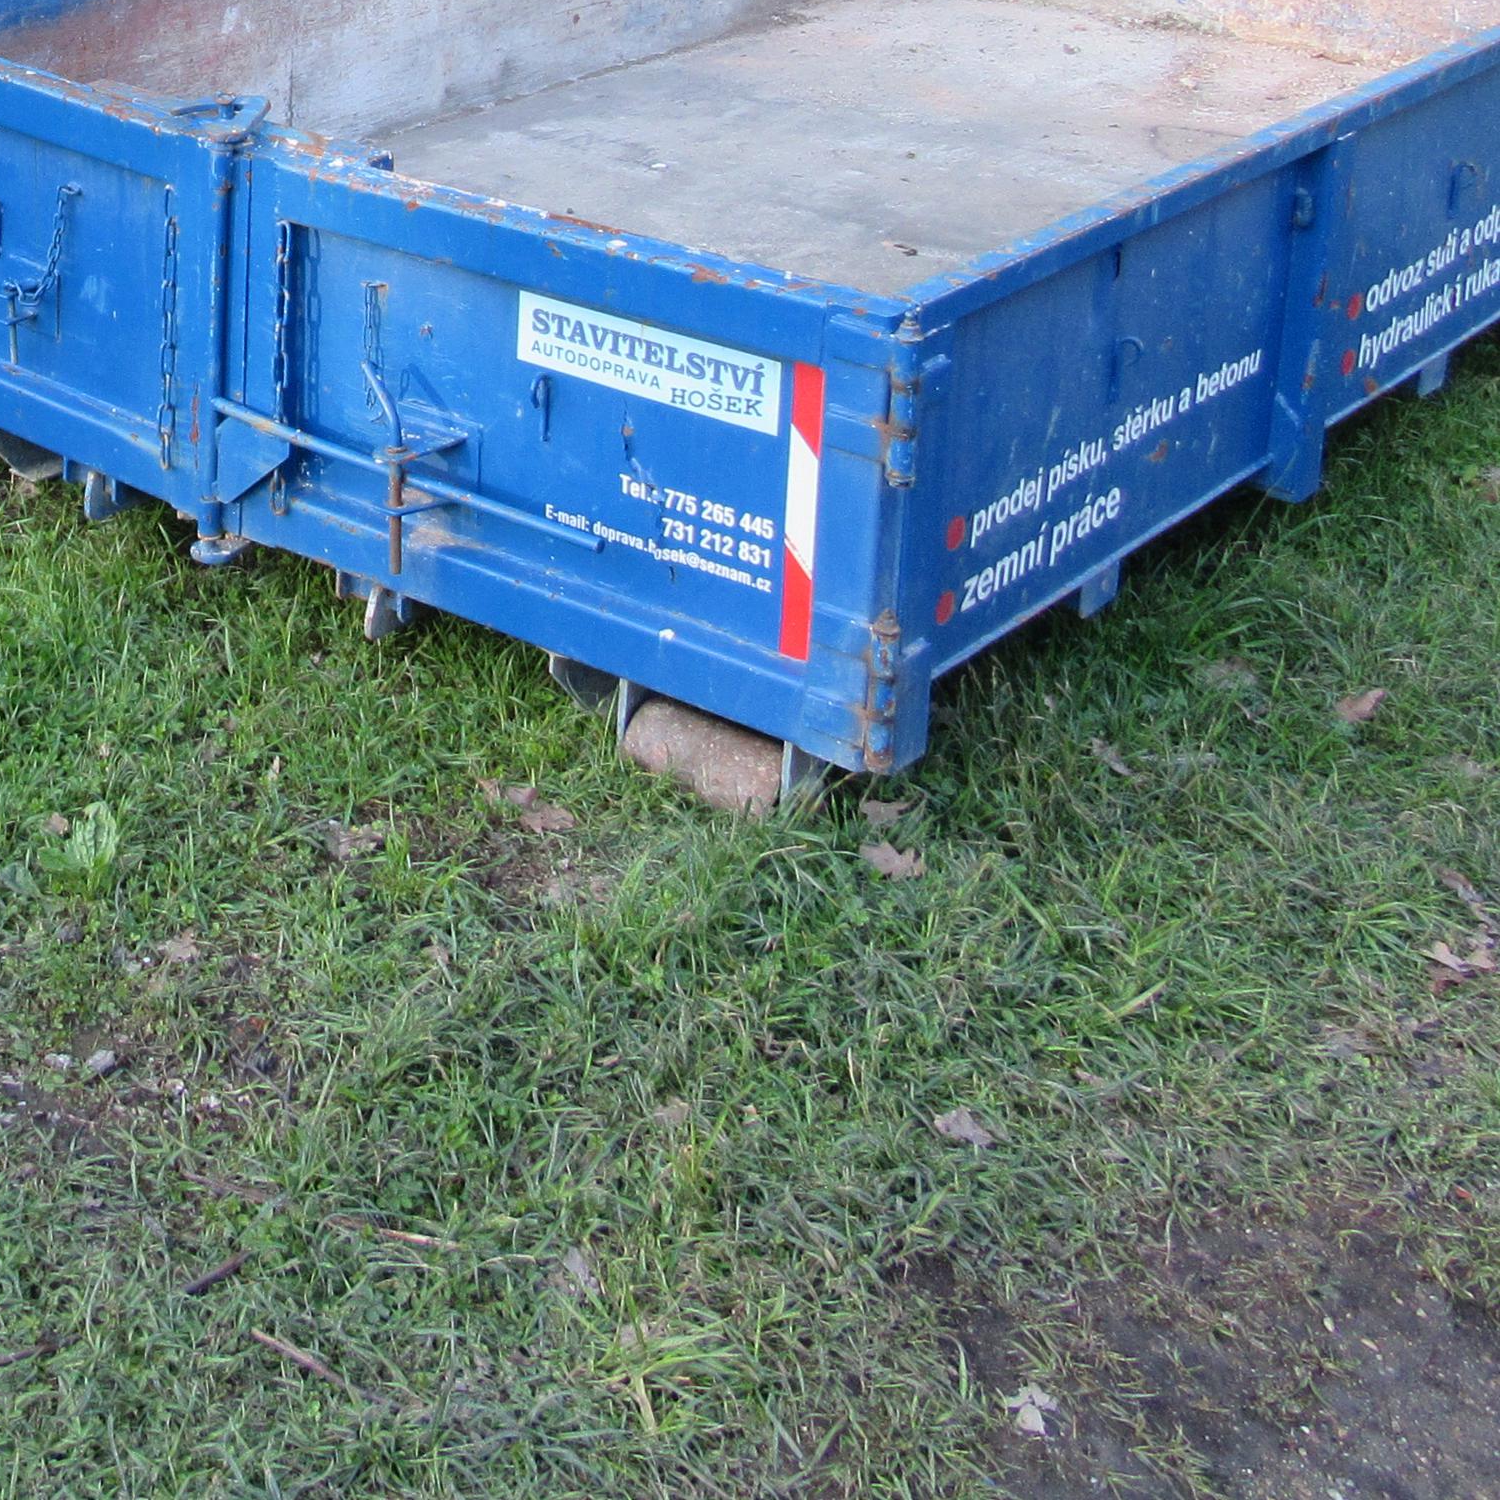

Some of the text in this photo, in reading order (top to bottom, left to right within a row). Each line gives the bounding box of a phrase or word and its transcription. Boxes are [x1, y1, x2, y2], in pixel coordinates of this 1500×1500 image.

[1366, 258, 1425, 312] odvoz
[1426, 227, 1458, 277] suti
[1459, 228, 1471, 255] a
[531, 308, 766, 397] STAVITELSTVÍ
[531, 340, 661, 389] AUTODOPRAVA
[670, 386, 763, 417] HOŠEK
[970, 349, 1262, 548] prodej písku, stěrku a betonu
[545, 504, 772, 593] E-mail: doprava.hosek@seznam.cz
[661, 517, 772, 569] 731 212 831
[663, 488, 698, 516] 775
[701, 500, 735, 529] 265
[739, 512, 774, 541] 445
[960, 486, 1121, 612] zemní práce
